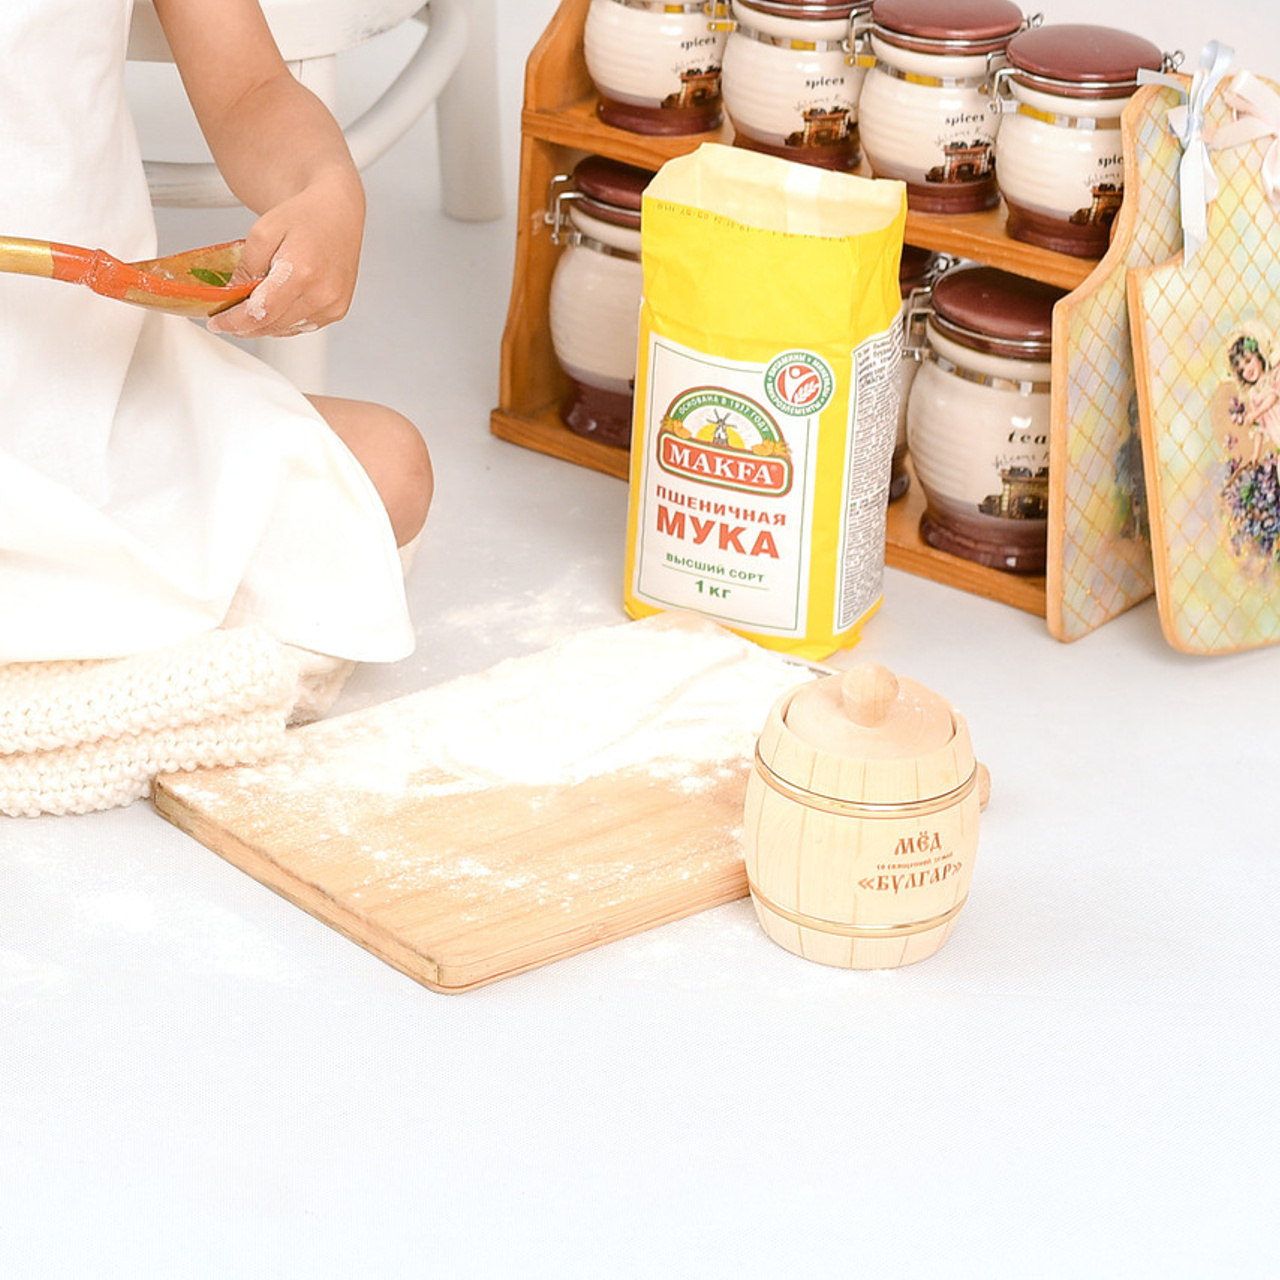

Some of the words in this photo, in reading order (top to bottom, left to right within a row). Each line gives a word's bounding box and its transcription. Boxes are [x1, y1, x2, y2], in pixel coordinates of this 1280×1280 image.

[681, 36, 716, 51] spices
[805, 76, 844, 90] spices
[945, 113, 984, 127] spices
[1098, 153, 1124, 168] spic
[678, 395, 719, 415] ОСНОВАНА
[730, 398, 749, 414] 1937
[751, 411, 770, 433] ГОДУ
[1008, 430, 1047, 444] tea
[668, 443, 774, 485] MAKFA
[656, 484, 787, 526] ПШЕНИЧНАЯ
[656, 503, 780, 559] МУКА
[666, 552, 725, 575] ВЫСШИЙ
[728, 568, 765, 583] СОРТ
[695, 579, 704, 594] 1
[894, 830, 942, 856] МЁД
